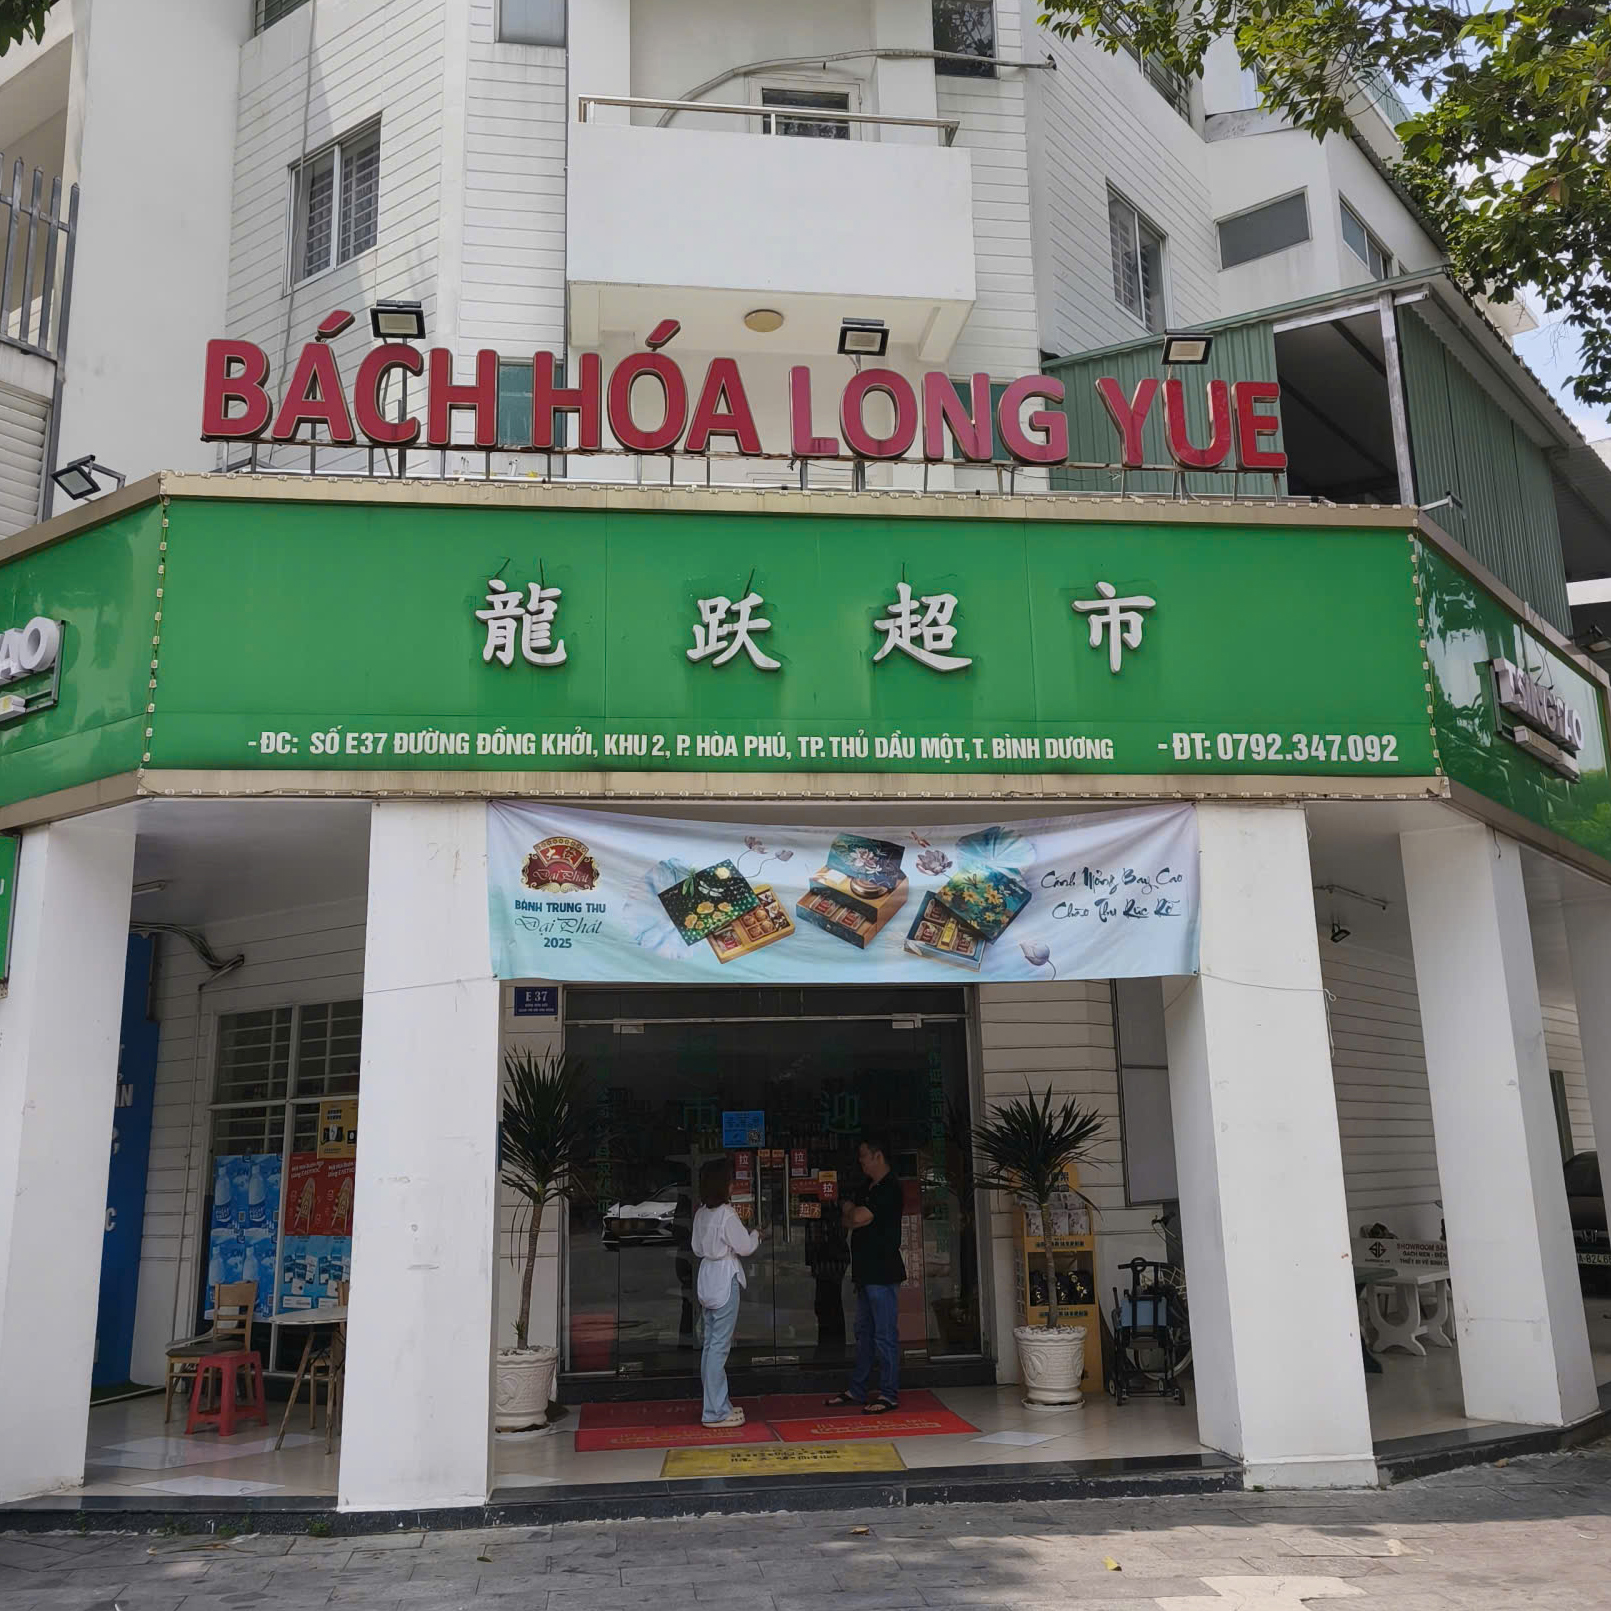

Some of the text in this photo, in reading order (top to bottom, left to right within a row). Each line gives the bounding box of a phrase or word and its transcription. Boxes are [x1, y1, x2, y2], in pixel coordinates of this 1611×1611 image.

[202, 310, 1287, 470] BÁCH HÓA LONG YUE
[475, 578, 1157, 674] 龍跃超市
[0, 616, 60, 686] AO
[309, 725, 343, 755] SỐ
[345, 732, 388, 754] E37
[393, 727, 469, 755] ĐƯỜNG
[476, 725, 536, 755] ĐỒNG
[541, 726, 598, 758] KHỞI,
[604, 734, 647, 756] KHU
[696, 731, 738, 757] HÒA
[744, 731, 792, 760] PHÚ,
[829, 729, 868, 758] THỦ
[875, 730, 915, 759] DẦU
[920, 733, 970, 763] MỘT,
[992, 733, 1040, 759] BÌNH
[1045, 735, 1114, 759] DƯƠNG
[1217, 733, 1399, 762] 0792.347.092
[546, 902, 582, 913] TRUNG
[586, 902, 606, 913] THU
[543, 937, 572, 949] 2025
[534, 991, 548, 1002] 37
[1396, 1243, 1435, 1252] SHOWROOM
